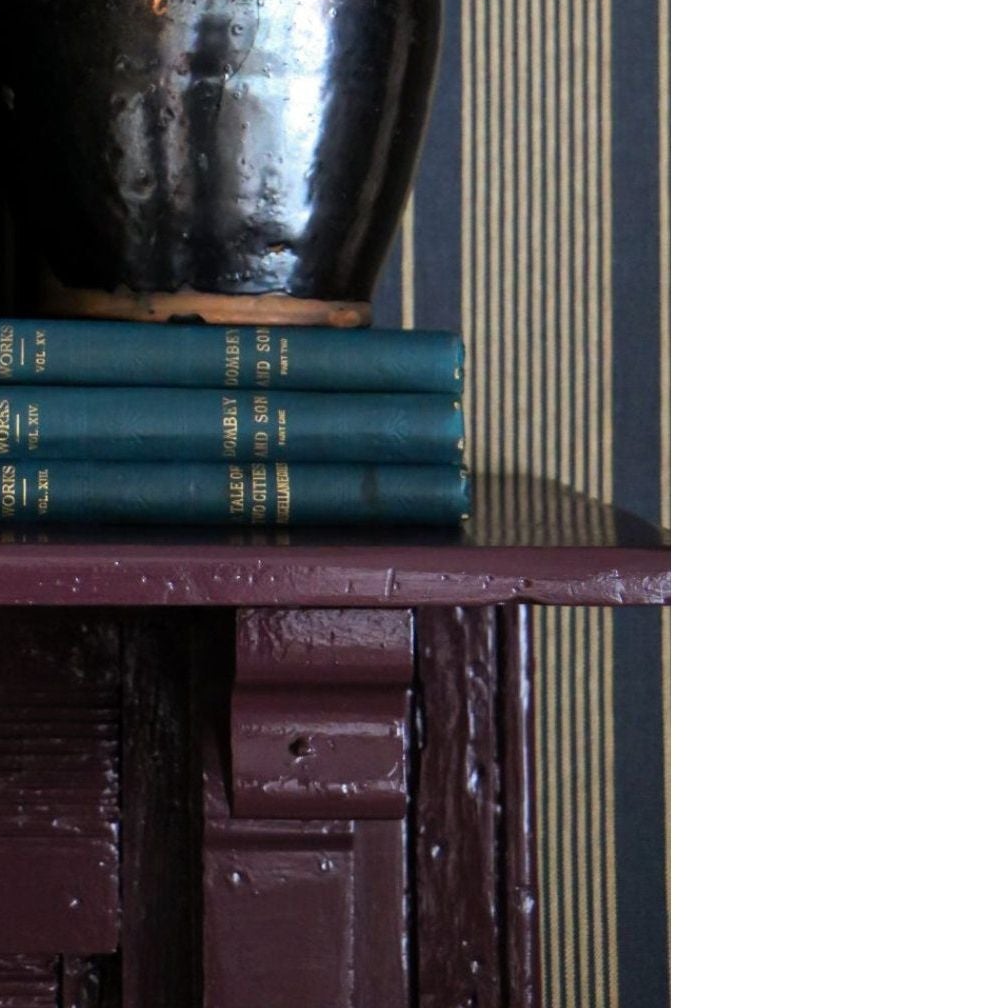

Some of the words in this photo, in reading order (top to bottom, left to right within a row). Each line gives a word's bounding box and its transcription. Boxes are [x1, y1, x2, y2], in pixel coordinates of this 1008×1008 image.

[0, 324, 13, 379] WORKS
[256, 360, 271, 387] AND
[254, 396, 269, 423] SON
[223, 396, 238, 457] DOMBEY
[254, 431, 269, 457] AND
[2, 465, 16, 518] WORKS
[230, 482, 244, 513] TALE
